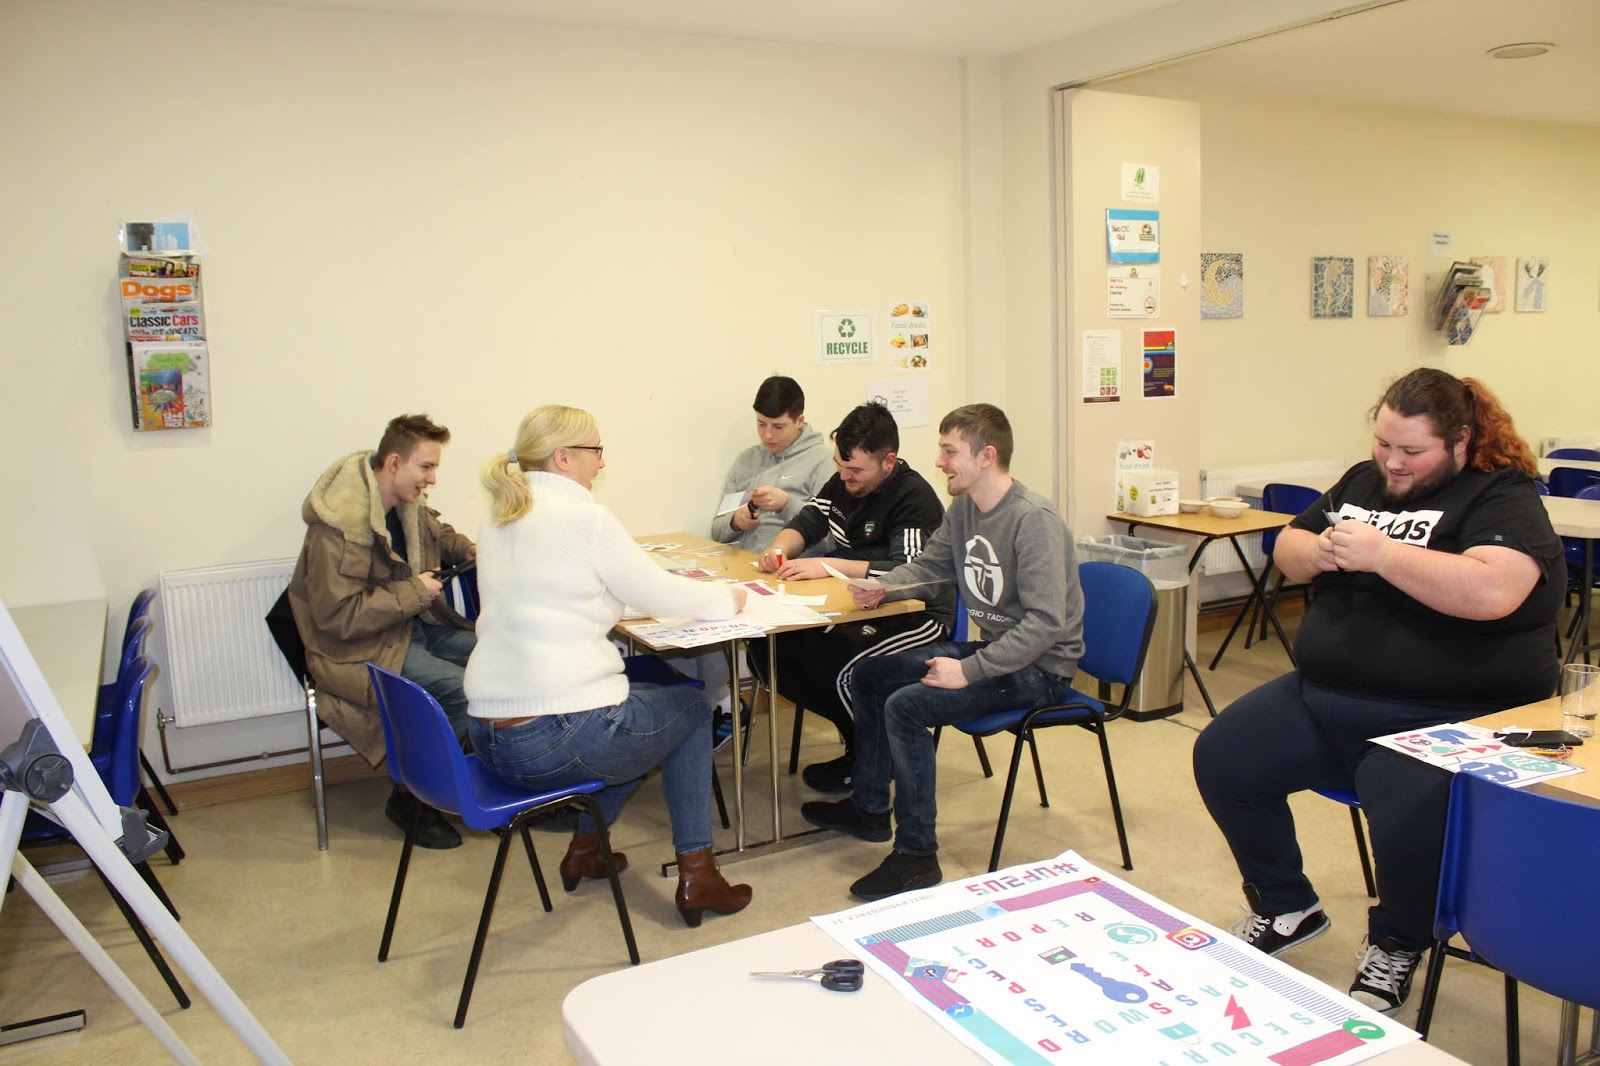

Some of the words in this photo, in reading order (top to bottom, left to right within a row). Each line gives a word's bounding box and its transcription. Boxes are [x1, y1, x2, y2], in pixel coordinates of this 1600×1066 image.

[122, 281, 192, 301] Dogs
[129, 315, 171, 328] Classic
[172, 314, 199, 327] Cars
[891, 321, 907, 329] Food
[908, 321, 927, 329] Waste
[826, 341, 869, 355] RECYCLE
